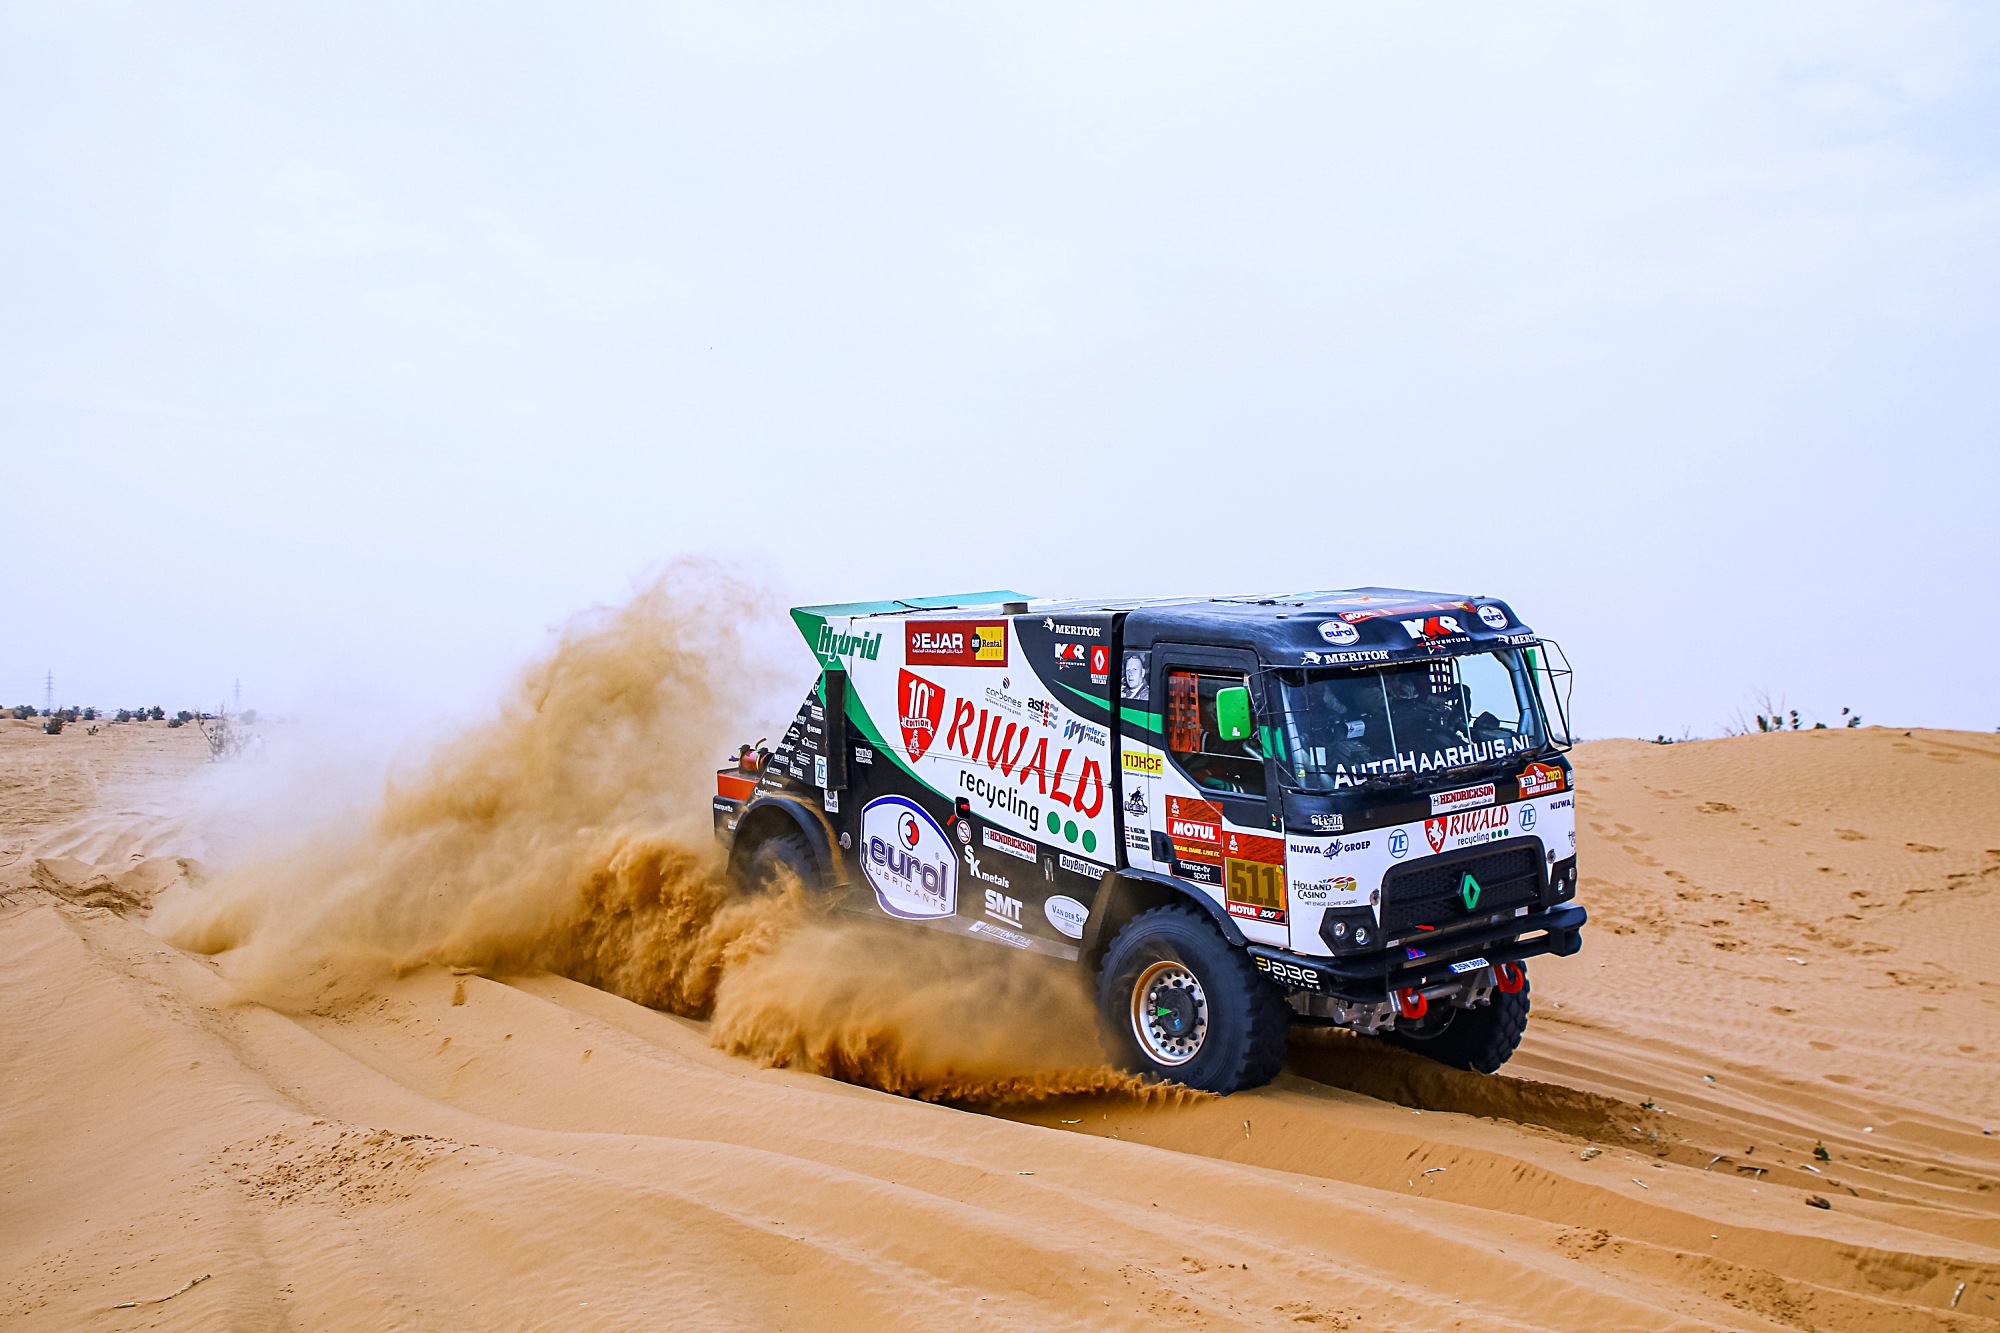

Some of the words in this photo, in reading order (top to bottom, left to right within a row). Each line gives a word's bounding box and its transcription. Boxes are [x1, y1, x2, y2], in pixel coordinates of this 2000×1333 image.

[1483, 612, 1503, 622] eurol
[1056, 625, 1101, 637] MERITOR
[1324, 627, 1355, 638] eurol
[817, 625, 882, 662] Hybrid
[982, 639, 1002, 648] Rental
[1425, 637, 1471, 646] ADVENTURE
[1324, 650, 1390, 664] MERITOR
[986, 687, 1022, 708] carbones
[1028, 697, 1044, 713] ast
[905, 719, 929, 728] EDITION
[947, 696, 1104, 819] RIWALD
[1123, 753, 1162, 771] TIJHOF
[1524, 777, 1533, 786] 511
[1546, 770, 1562, 781] 2021
[1440, 785, 1494, 805] HENDRICKSON
[1526, 785, 1541, 795] SAUDI
[960, 770, 1039, 832] recycling
[1550, 799, 1571, 810] NIJWA
[1449, 806, 1509, 837] RIWALD
[1520, 807, 1536, 827] ZF
[1172, 821, 1216, 840] MOTUL
[1457, 831, 1490, 846] recycling
[989, 831, 1036, 854] HENDRICKSON
[1290, 844, 1321, 854] NIJWA
[1344, 841, 1371, 852] GROEP
[1389, 833, 1408, 854] ZF
[870, 835, 948, 901] eurol
[1062, 855, 1103, 878] BuyBigTyres
[981, 871, 1010, 888] metals
[1193, 872, 1211, 881] sport
[868, 864, 947, 912] LUBRICANTS
[1231, 861, 1280, 909] 511
[1293, 880, 1332, 891] HOLLAND
[1298, 889, 1327, 900] CASINO
[985, 889, 1023, 921] SMT
[1052, 904, 1064, 916] VAN
[1064, 911, 1075, 920] DER
[1229, 904, 1257, 916] MOTUL
[1260, 909, 1284, 920] 300V
